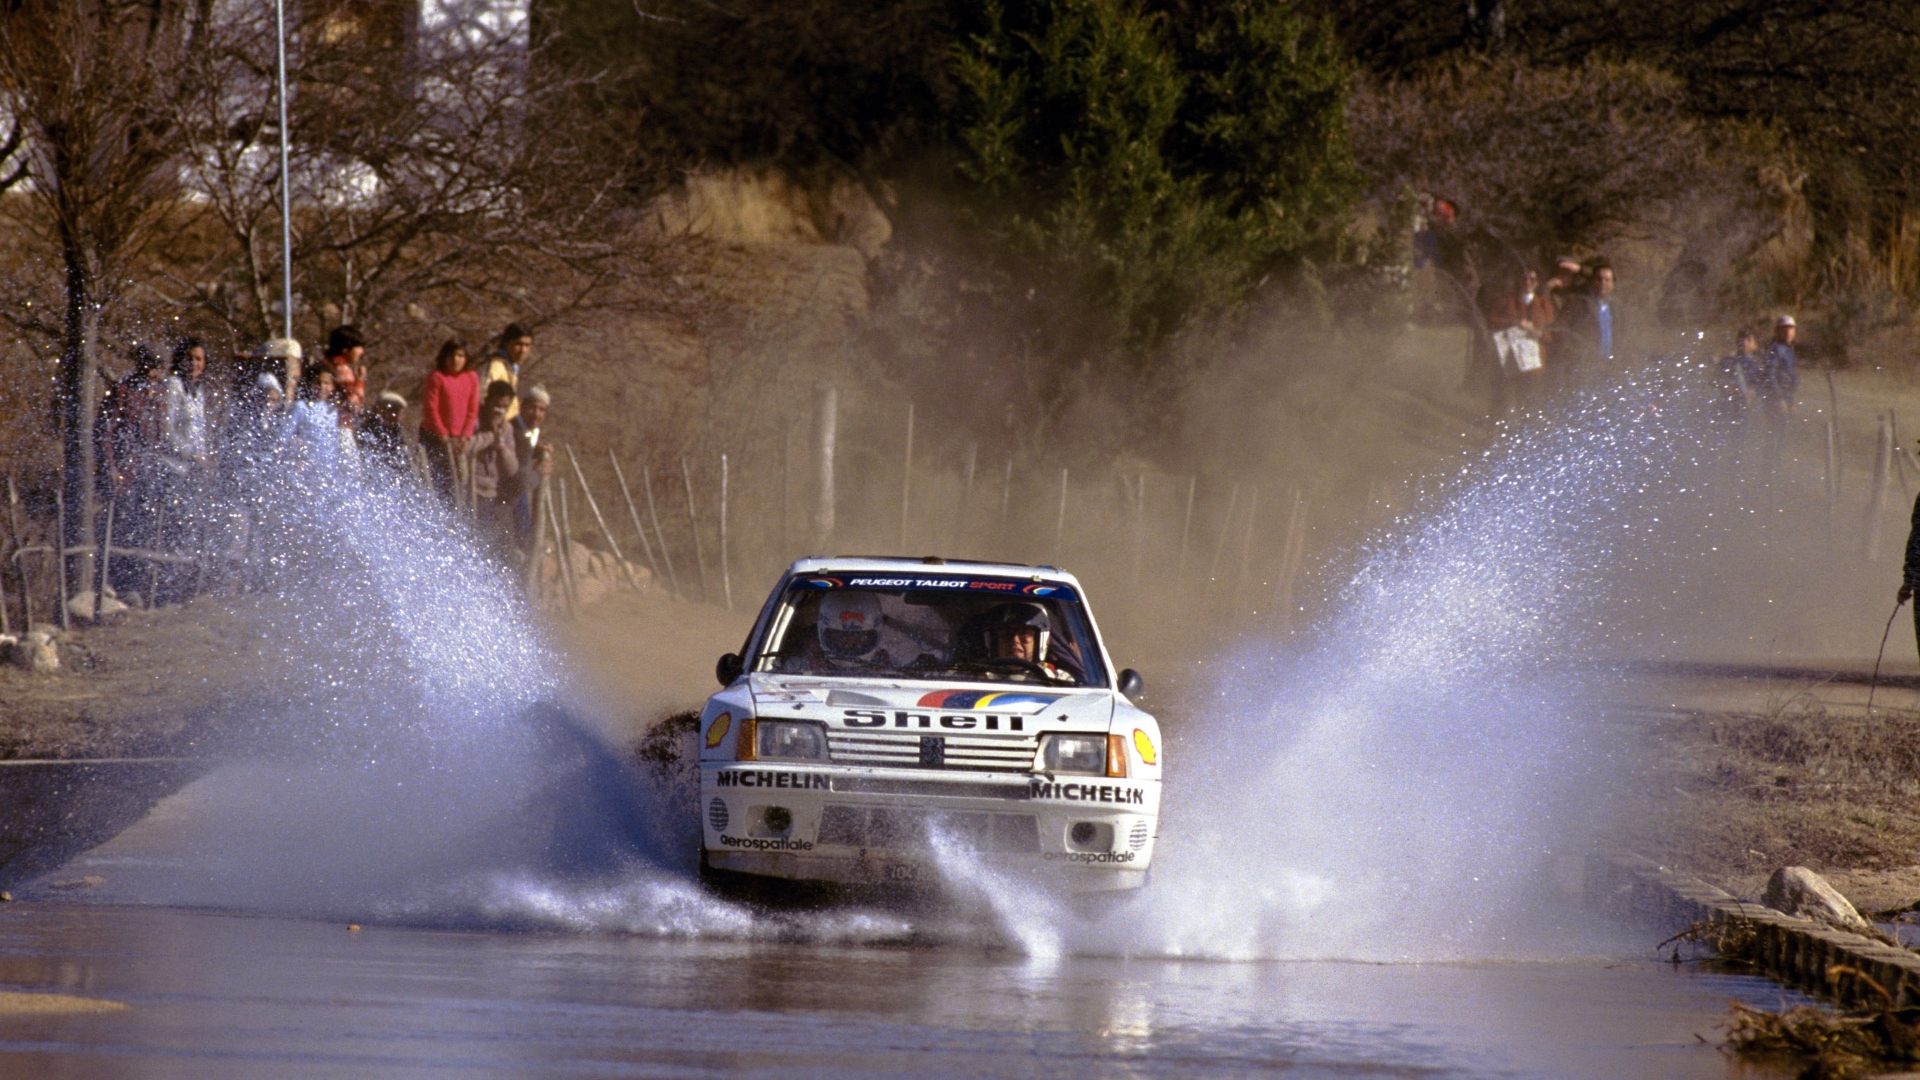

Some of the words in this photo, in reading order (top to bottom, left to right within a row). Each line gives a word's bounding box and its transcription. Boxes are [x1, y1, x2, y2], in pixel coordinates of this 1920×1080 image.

[850, 578, 913, 587] PEUGEOT
[915, 579, 968, 588] TALBOT
[969, 581, 1017, 591] SPORT
[843, 709, 1024, 731] Shell
[717, 770, 831, 789] MICHELIN
[1031, 782, 1144, 805] MICHELIN
[720, 834, 813, 851] aerospatiale
